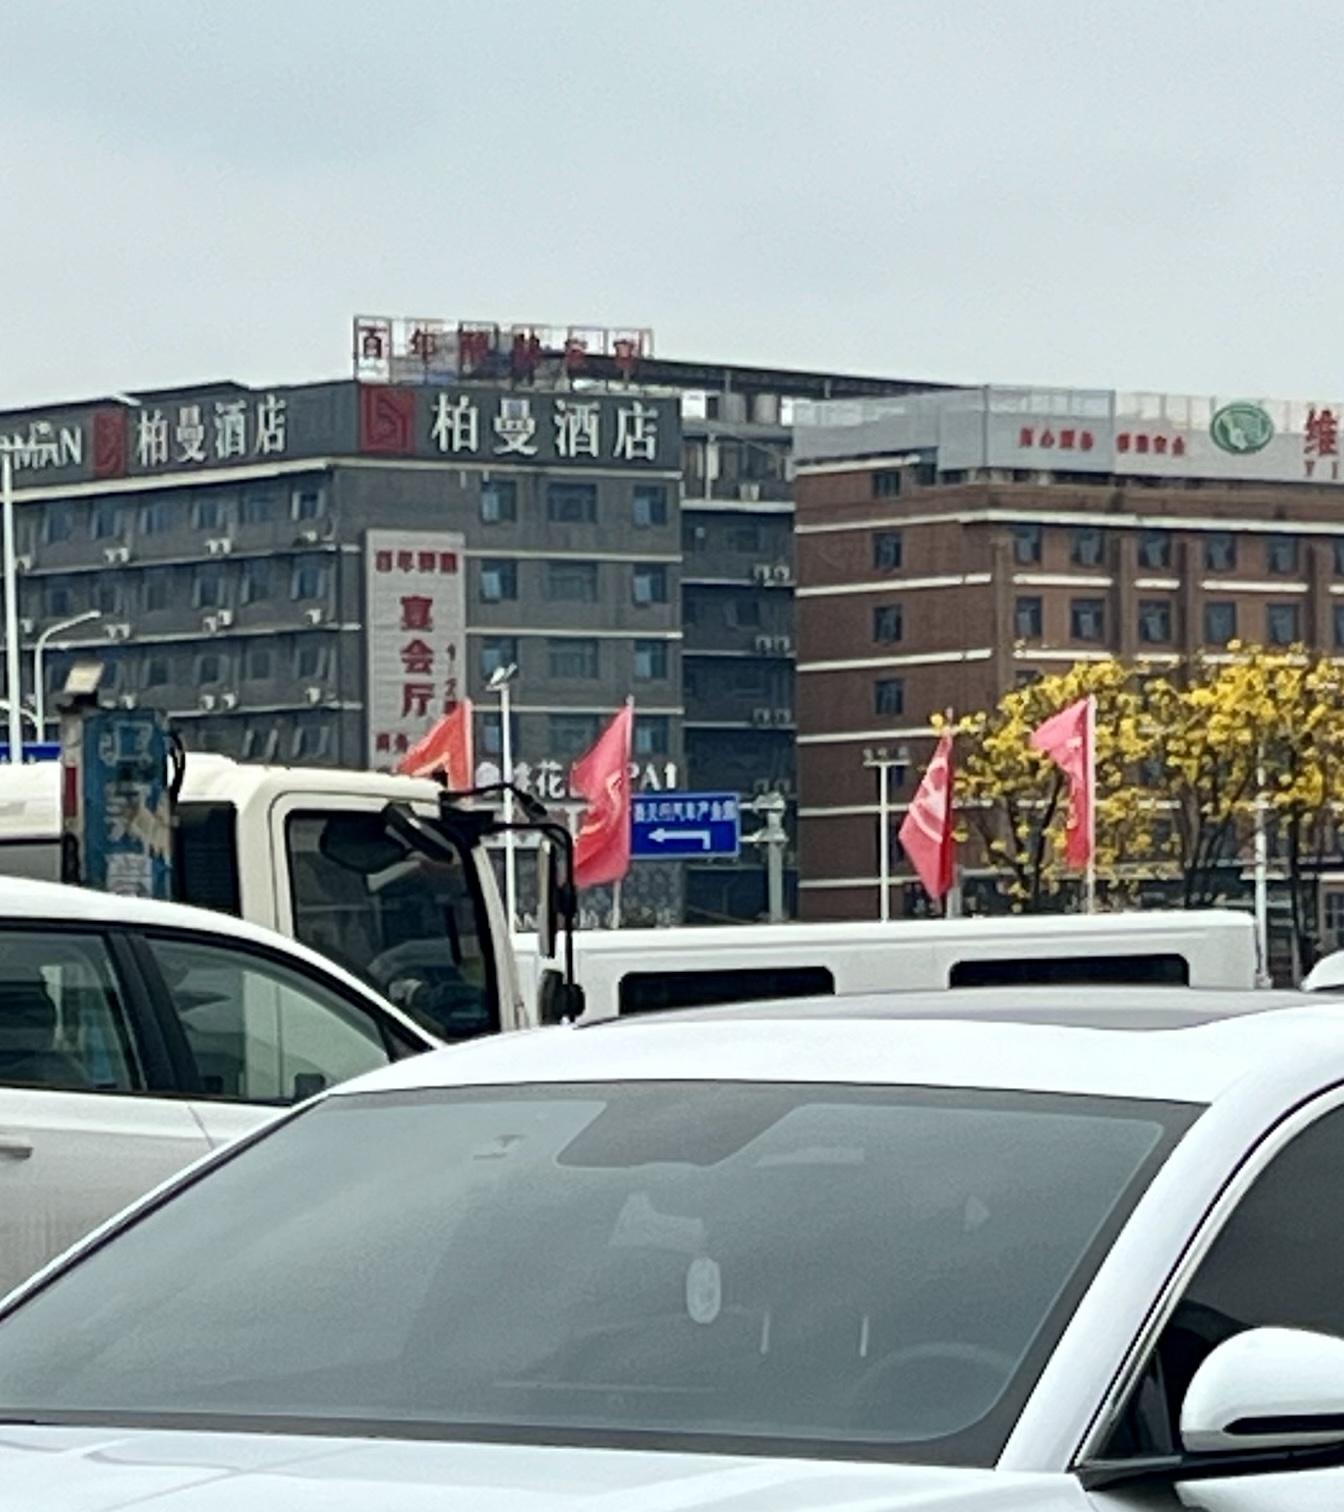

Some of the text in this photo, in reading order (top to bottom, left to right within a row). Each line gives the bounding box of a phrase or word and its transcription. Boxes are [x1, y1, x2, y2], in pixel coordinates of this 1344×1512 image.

[136, 394, 287, 466] 柏曼酒店
[430, 392, 658, 461] 柏曼酒店
[400, 595, 435, 718] 宴会厅
